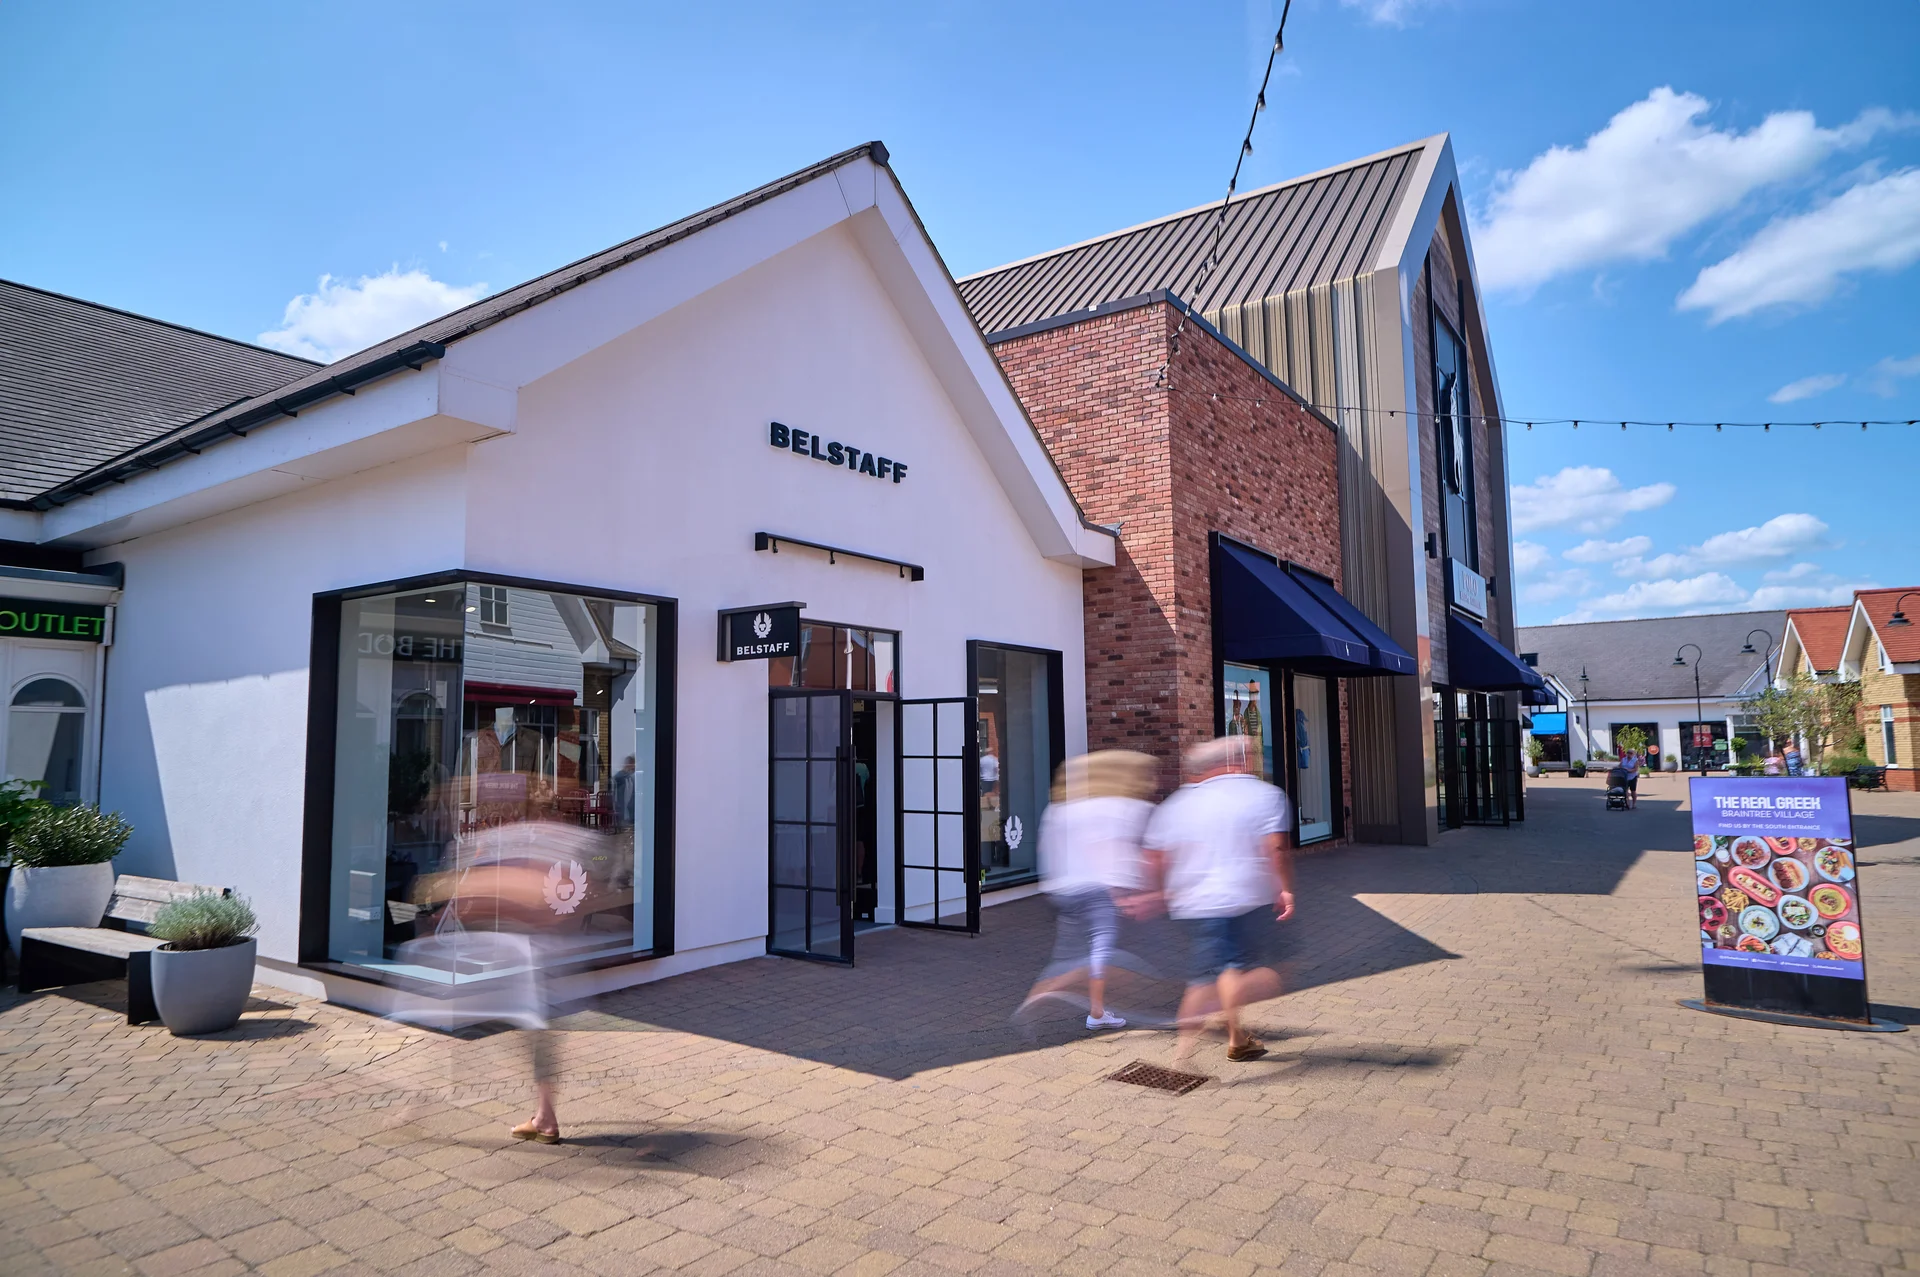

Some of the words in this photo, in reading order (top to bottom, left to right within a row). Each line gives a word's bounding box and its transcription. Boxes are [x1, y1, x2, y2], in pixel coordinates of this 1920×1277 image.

[770, 421, 908, 483] BELSTAFF
[0, 611, 106, 636] OUTLET
[737, 642, 790, 655] BELSTAFF
[1714, 796, 1739, 809] THE
[1741, 796, 1775, 809] REAL
[1775, 797, 1821, 809] GREEK
[1721, 810, 1772, 818] BRAINTREE
[1773, 810, 1815, 819] VILLAGE
